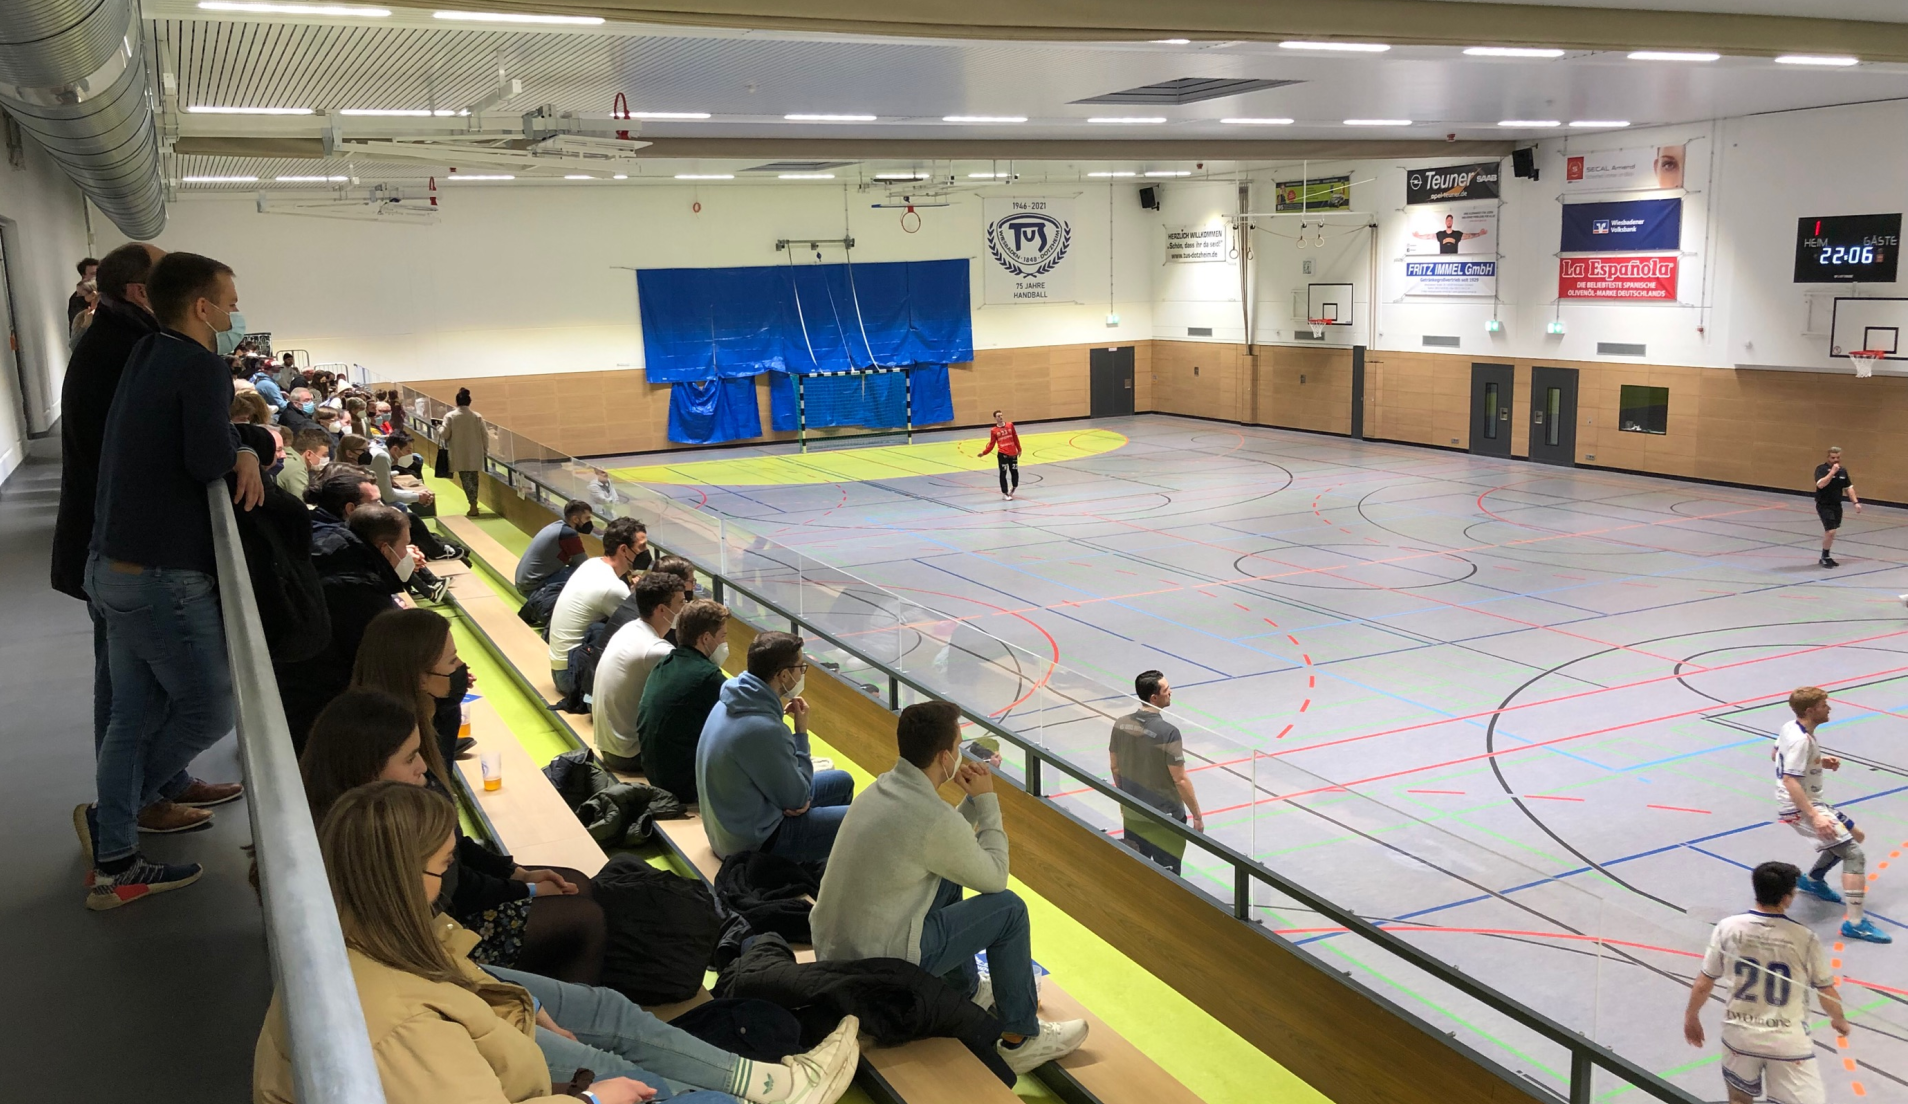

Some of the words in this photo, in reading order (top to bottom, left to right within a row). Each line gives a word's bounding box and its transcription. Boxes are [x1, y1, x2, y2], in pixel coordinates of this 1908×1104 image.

[1426, 172, 1475, 190] Teuner
[1476, 174, 1498, 183] SAAB
[1190, 230, 1222, 239] WILLKOMMEN
[1804, 238, 1828, 248] HEIM
[1863, 235, 1898, 246] GÄSTE
[999, 230, 1020, 260] WIESBADEN
[1040, 230, 1060, 259] DOTZHEIM
[1819, 246, 1874, 264] 22:06
[1408, 264, 1434, 275] FRITZ
[1435, 264, 1463, 275] IMMEL
[1465, 263, 1494, 275] GmbH
[1562, 260, 1585, 278] La
[1588, 258, 1672, 281] Española
[1734, 956, 1792, 1007] 20
